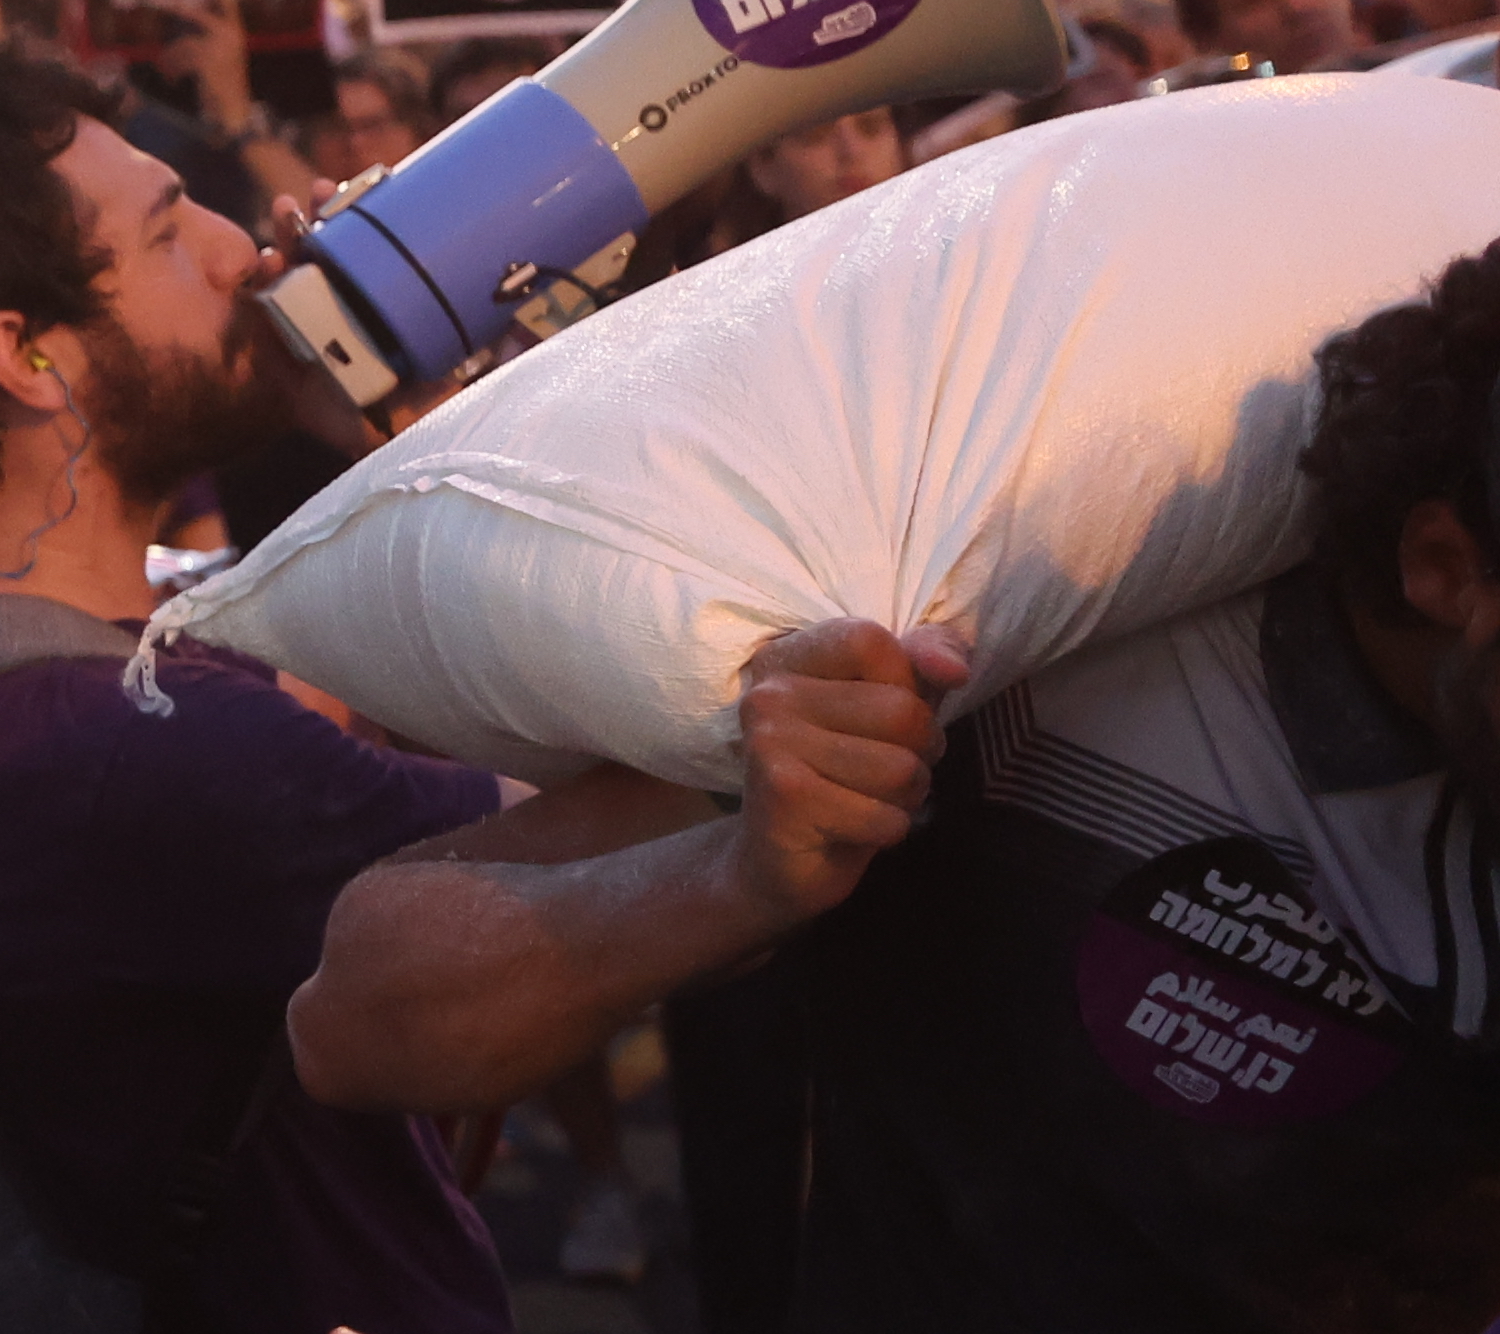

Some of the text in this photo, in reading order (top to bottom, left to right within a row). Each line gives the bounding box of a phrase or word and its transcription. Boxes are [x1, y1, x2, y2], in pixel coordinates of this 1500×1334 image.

[1149, 888, 1329, 989] למלחמה
[1145, 970, 1242, 1023] سلام
[1125, 998, 1248, 1075] שלום
